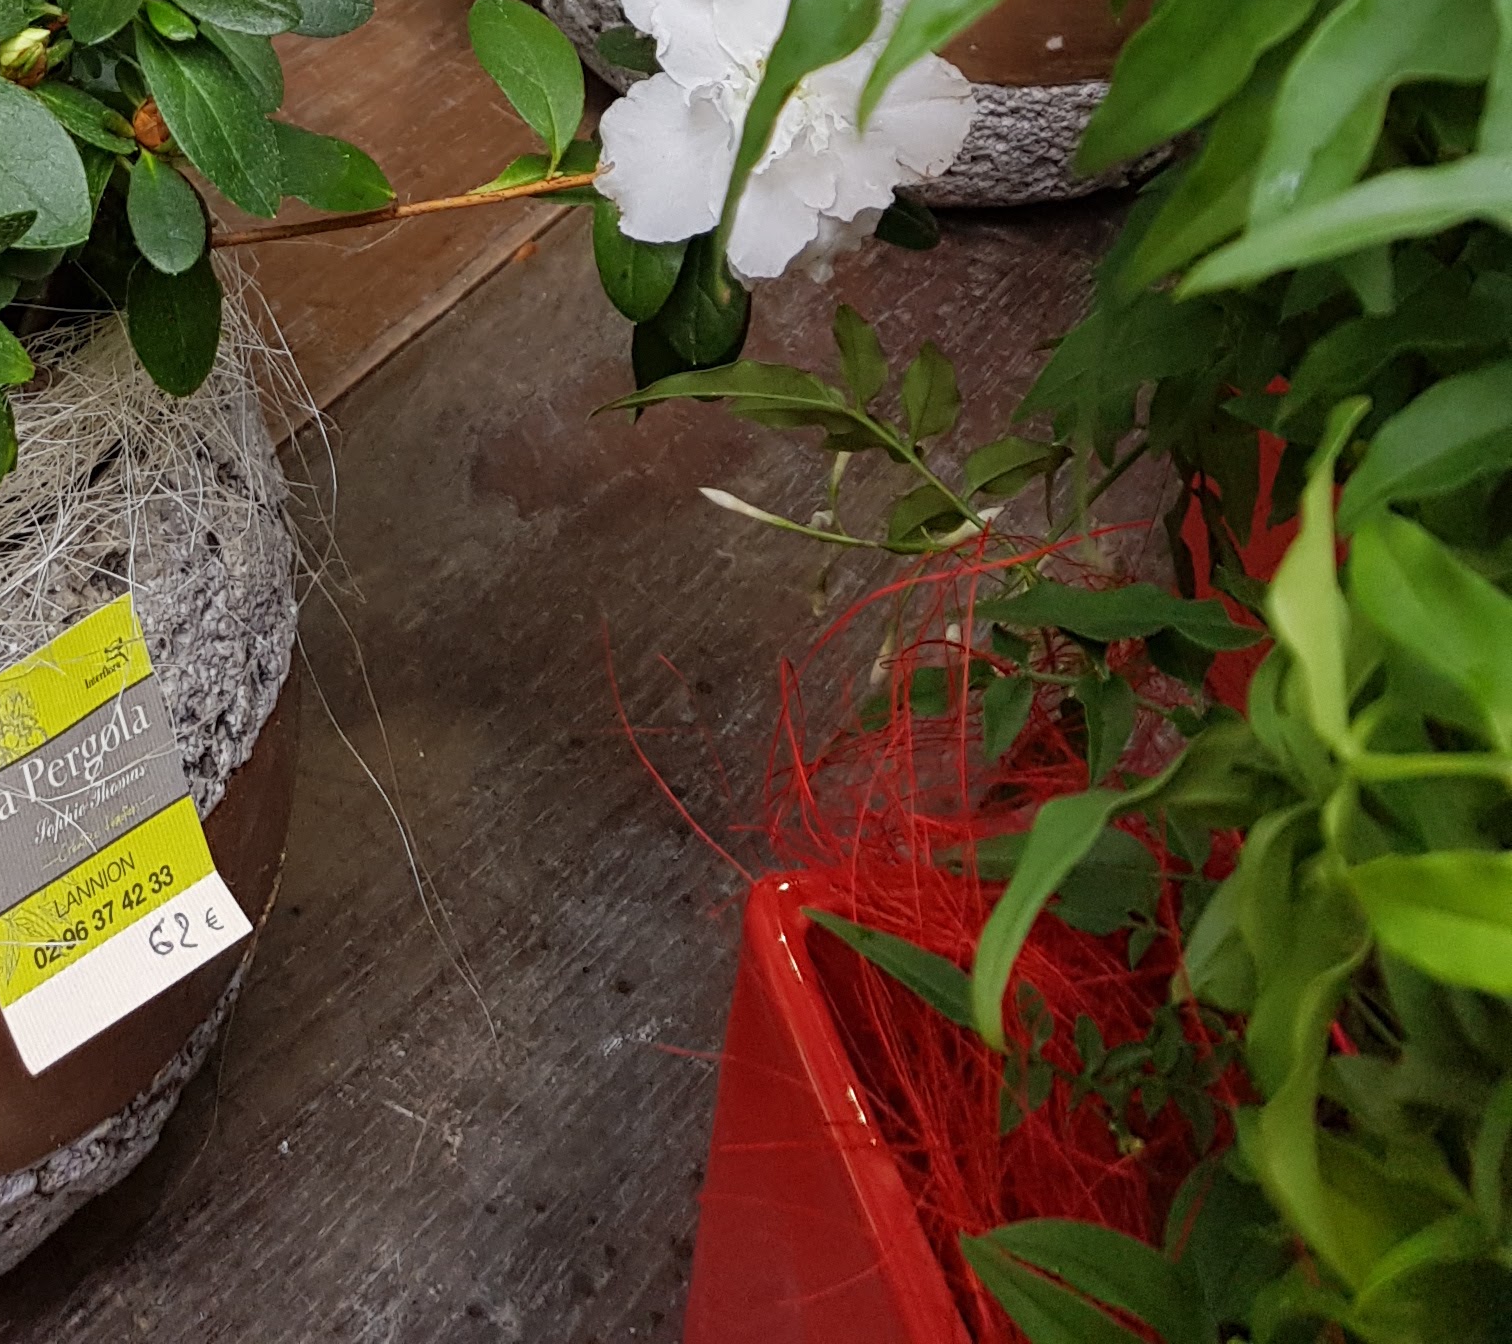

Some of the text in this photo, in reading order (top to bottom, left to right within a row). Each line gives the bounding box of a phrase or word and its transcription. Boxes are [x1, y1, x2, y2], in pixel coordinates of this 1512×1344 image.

[19, 703, 153, 803] Pergola
[90, 766, 145, 808] Thomas
[34, 865, 174, 970] 02 96 37 42 33
[53, 851, 136, 918] LANNION
[148, 907, 224, 955] 62 €
